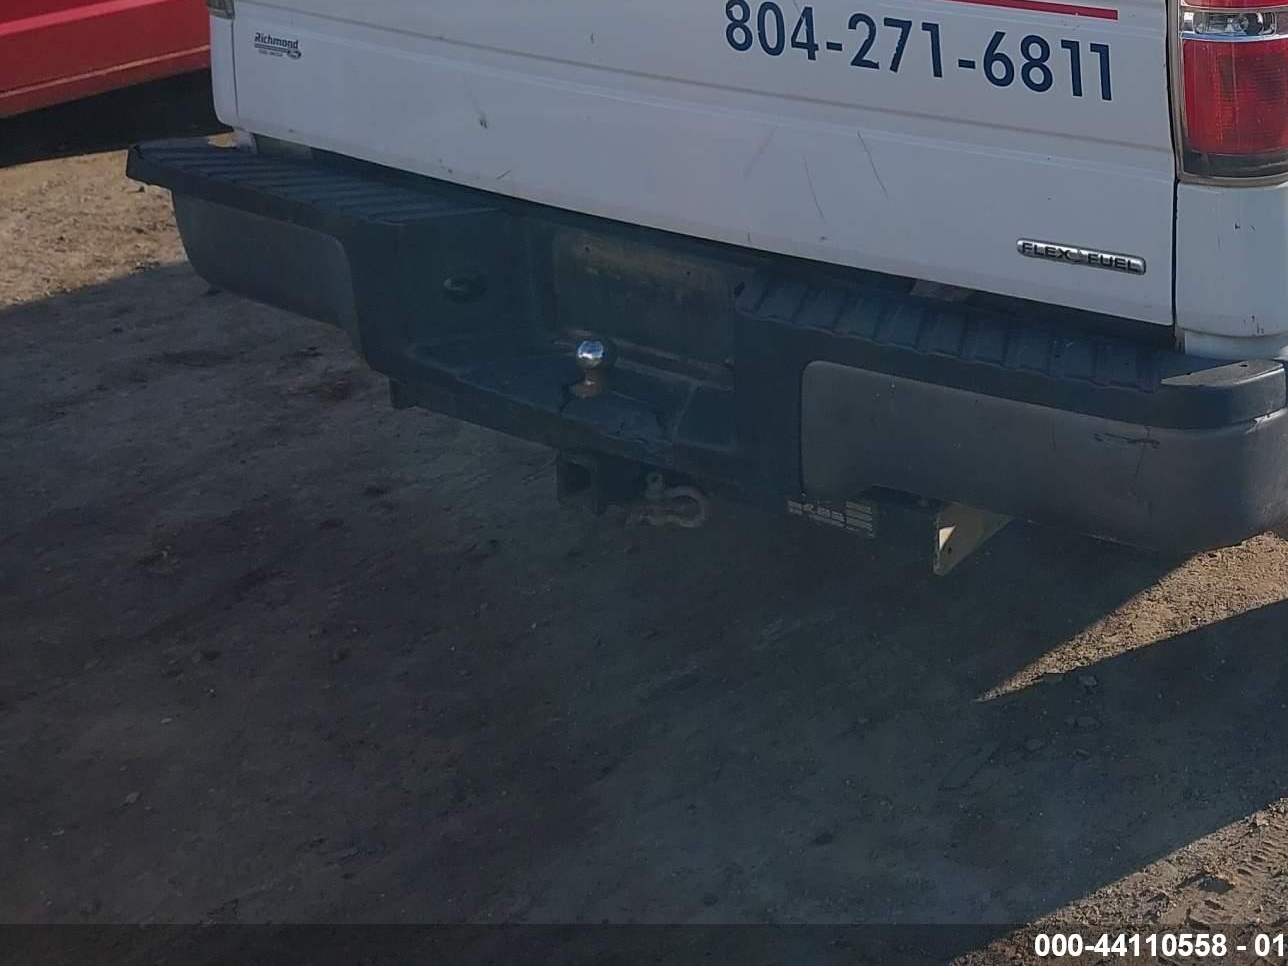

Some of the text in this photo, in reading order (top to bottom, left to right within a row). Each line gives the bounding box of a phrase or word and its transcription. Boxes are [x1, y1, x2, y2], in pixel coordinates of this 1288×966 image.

[255, 32, 299, 50] Richmond
[1022, 242, 1141, 273] FLEX FUEL
